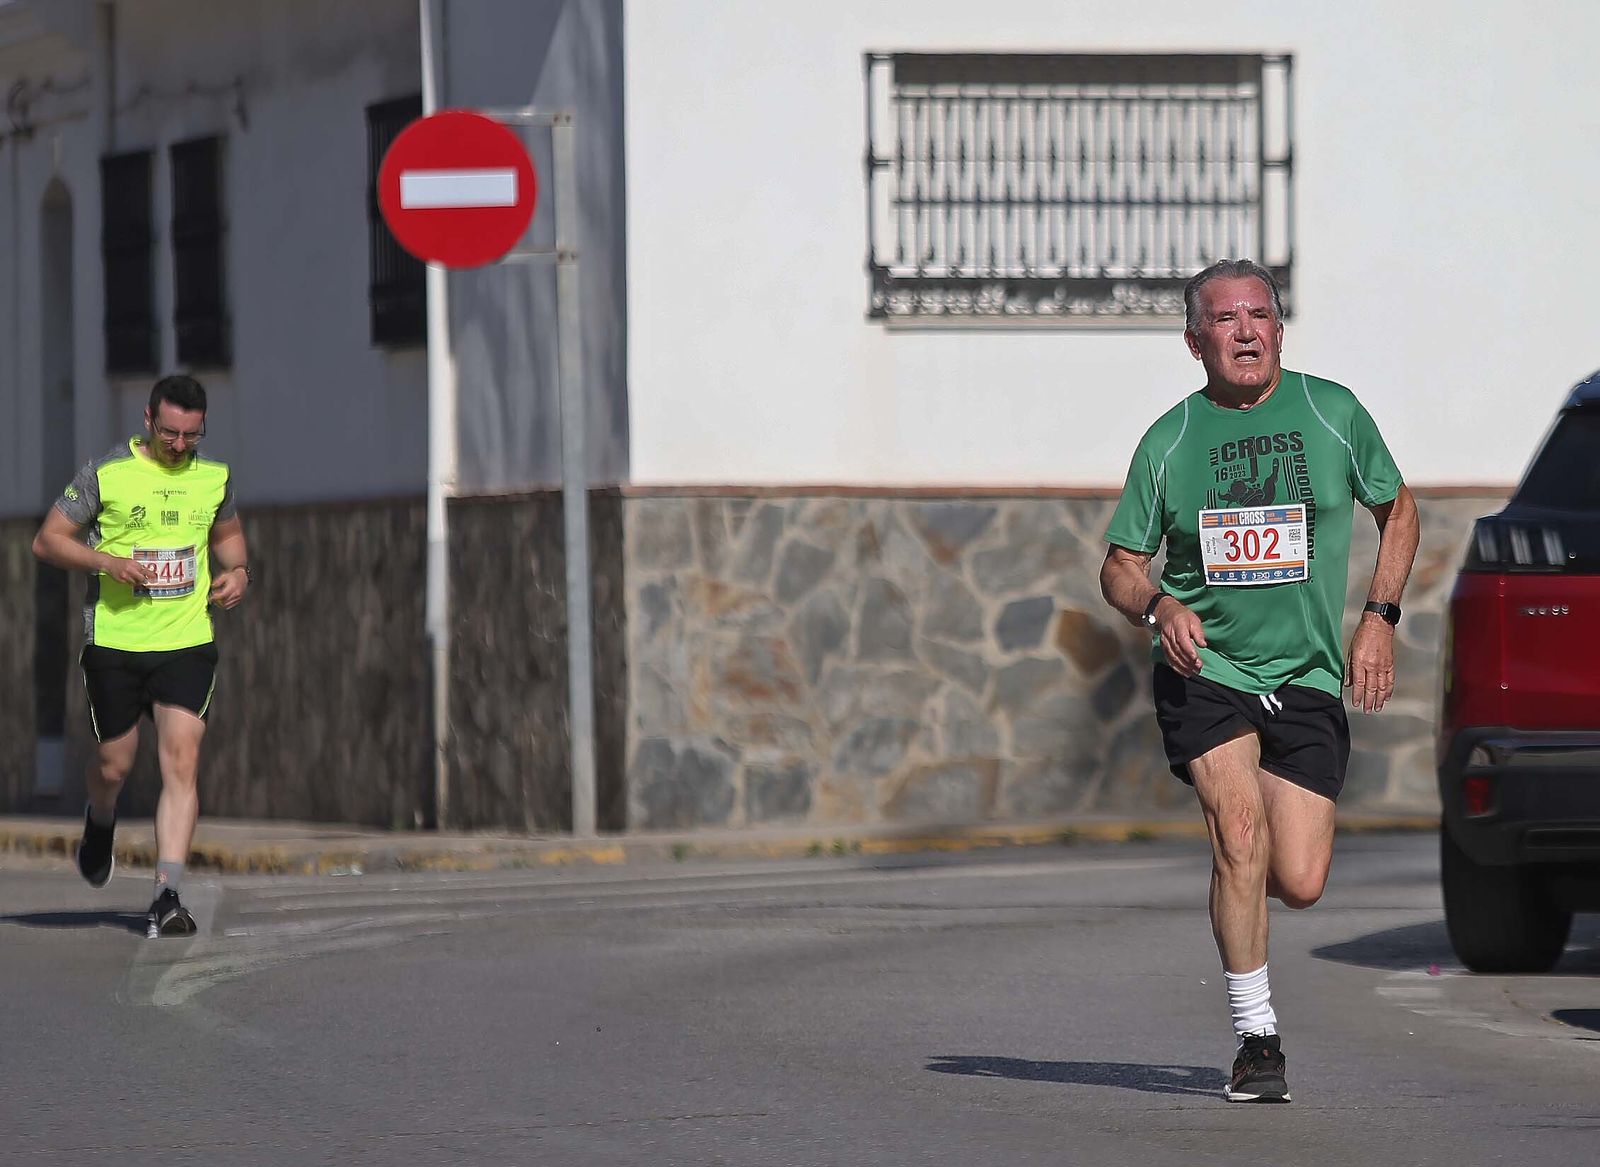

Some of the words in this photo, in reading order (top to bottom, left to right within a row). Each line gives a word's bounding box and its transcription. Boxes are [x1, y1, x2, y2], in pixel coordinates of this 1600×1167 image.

[1221, 431, 1304, 462] CROSS
[1215, 468, 1228, 483] 16
[1230, 472, 1247, 480] 2023
[1238, 511, 1266, 526] CROSS
[1223, 527, 1281, 562] 302
